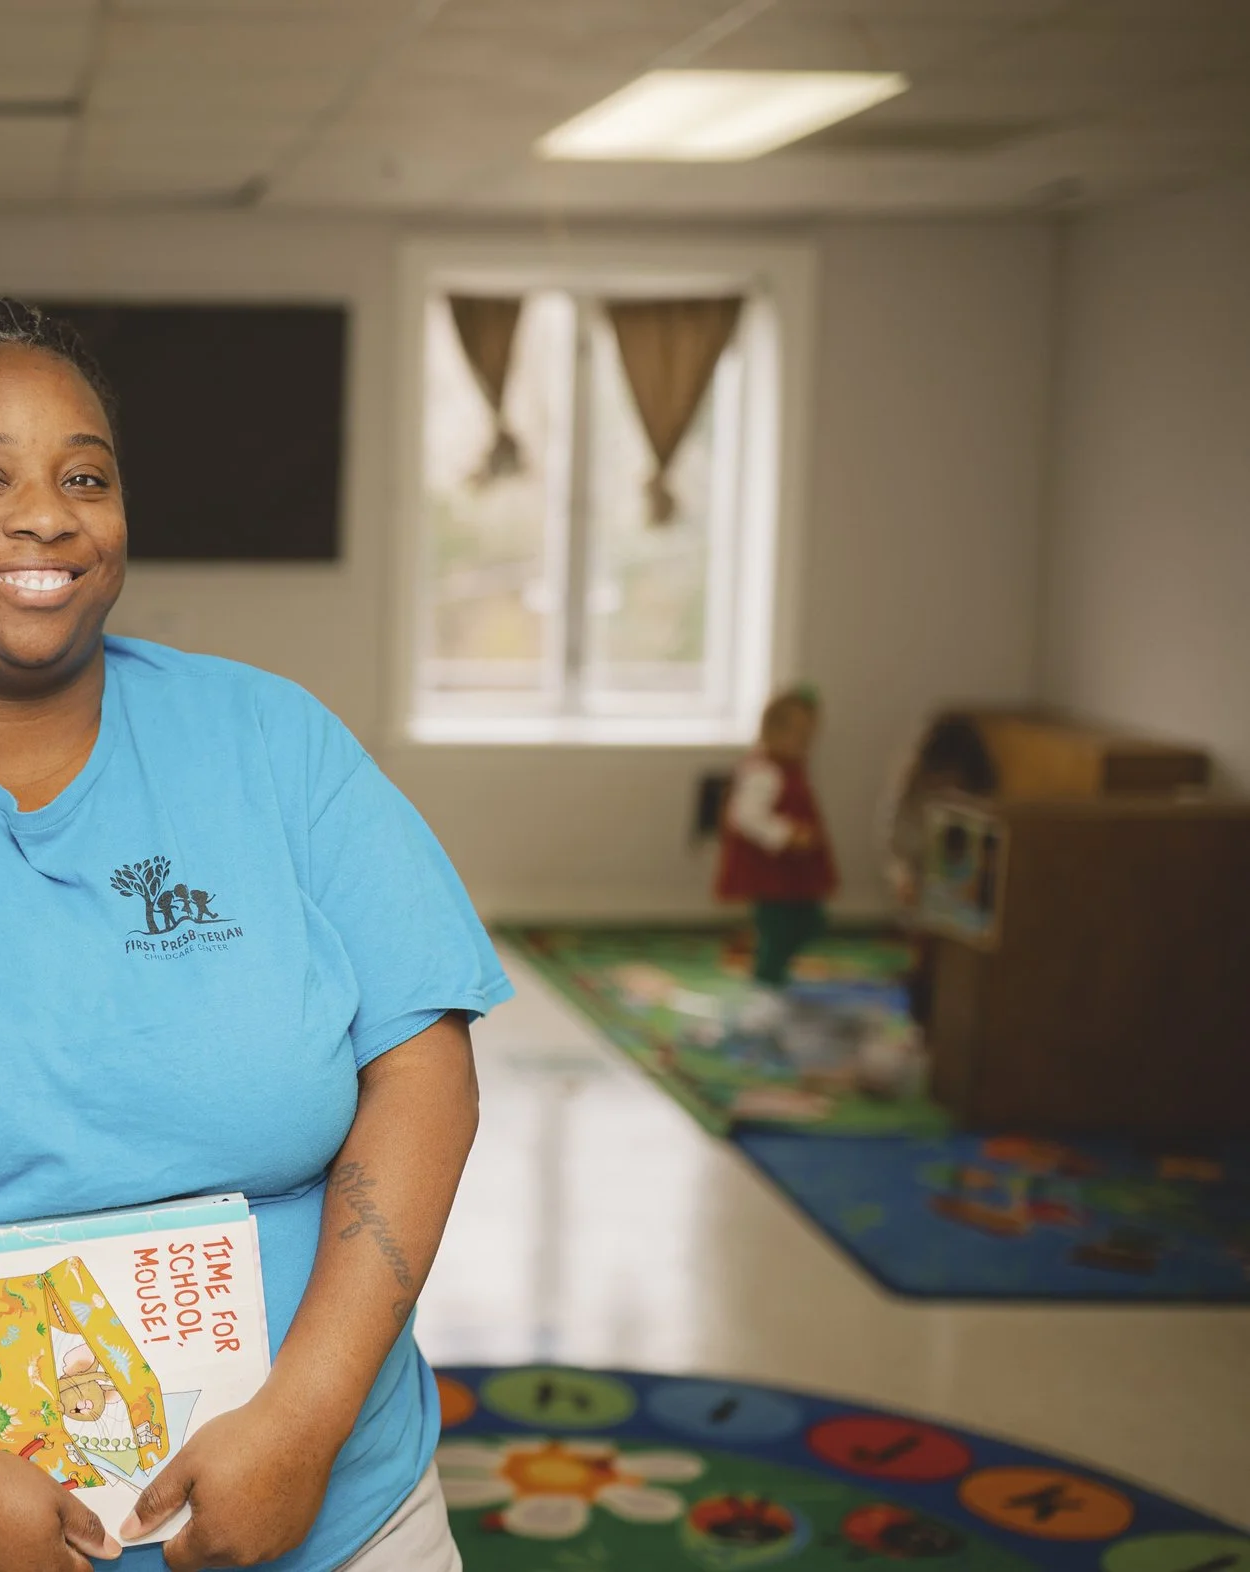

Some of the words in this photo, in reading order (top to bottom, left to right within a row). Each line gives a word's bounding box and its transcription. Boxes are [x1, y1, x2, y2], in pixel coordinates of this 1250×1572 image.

[125, 940, 156, 954] FIRST
[161, 926, 244, 952] PRESBTERIAN
[144, 944, 195, 961] CHILDCARE
[202, 1235, 234, 1300] TIME
[168, 1242, 203, 1347] SCHOOL,
[211, 1310, 241, 1353] FOR
